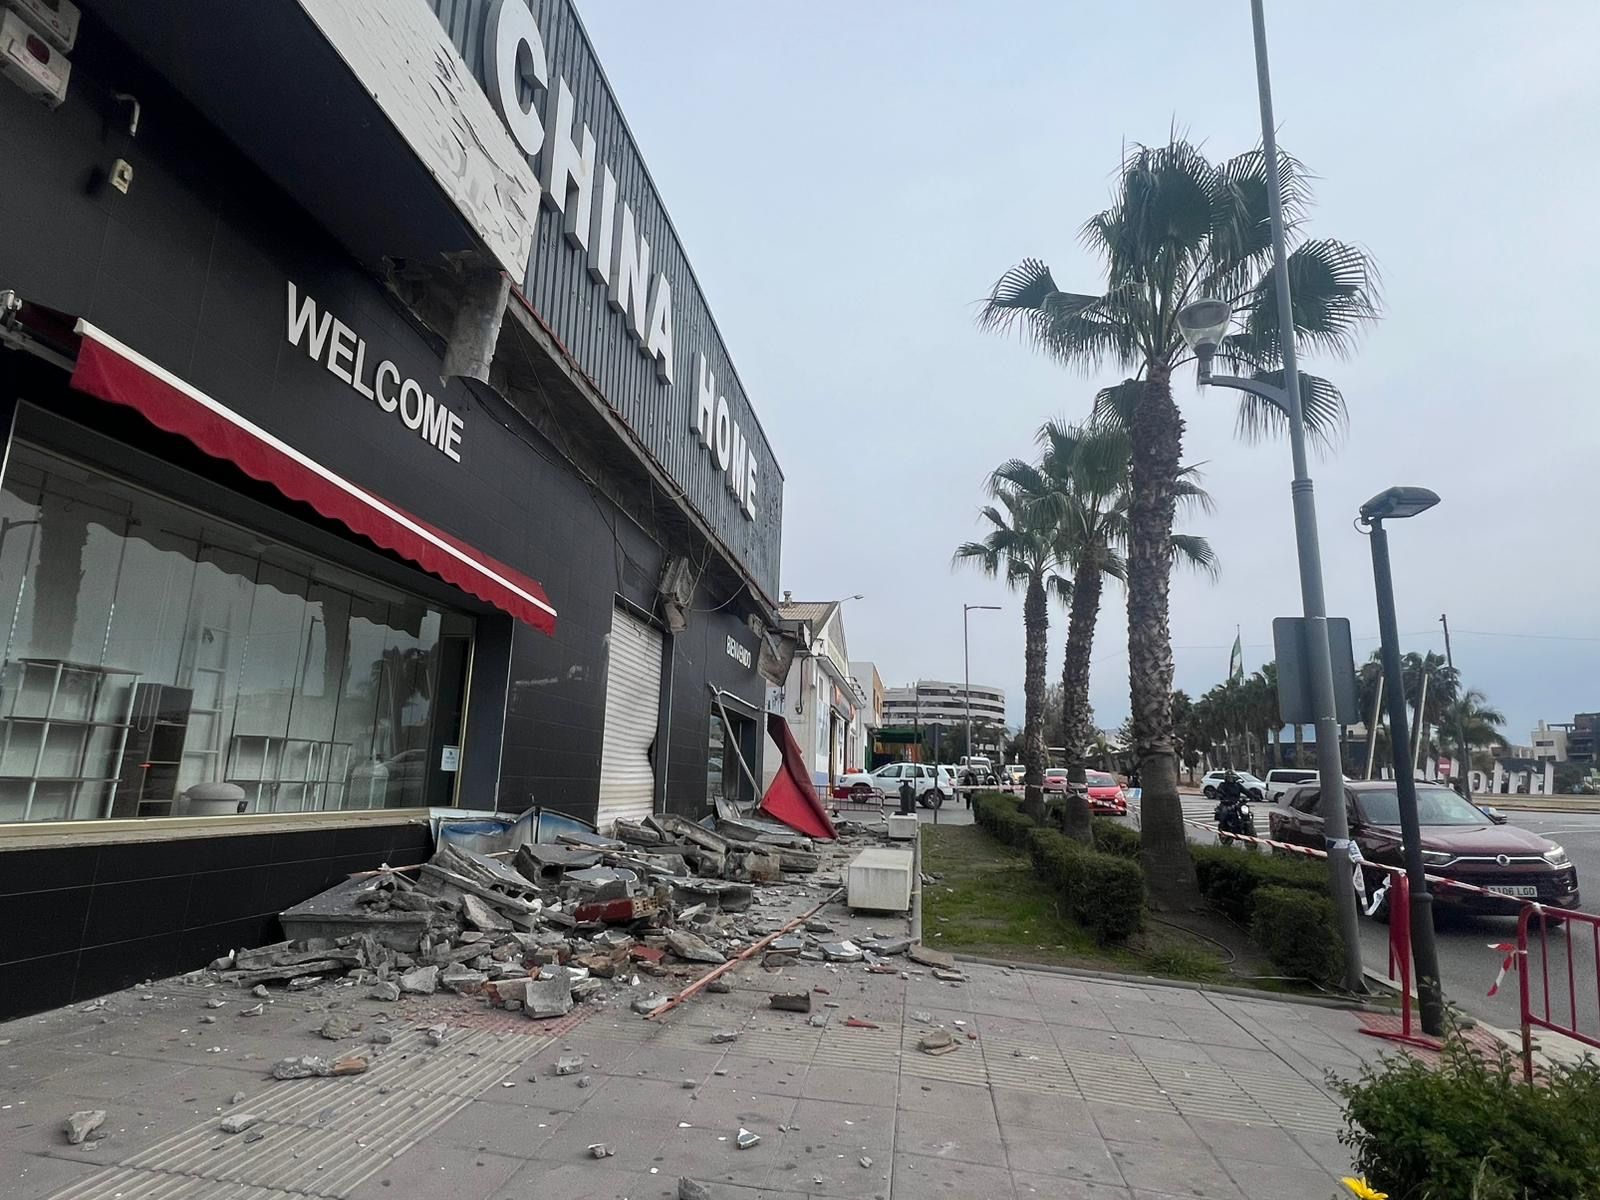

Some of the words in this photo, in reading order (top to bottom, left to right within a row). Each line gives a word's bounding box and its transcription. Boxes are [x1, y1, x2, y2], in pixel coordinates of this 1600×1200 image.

[288, 280, 464, 463] WELCOME
[485, 0, 673, 386] CHINA
[690, 351, 757, 521] HOME
